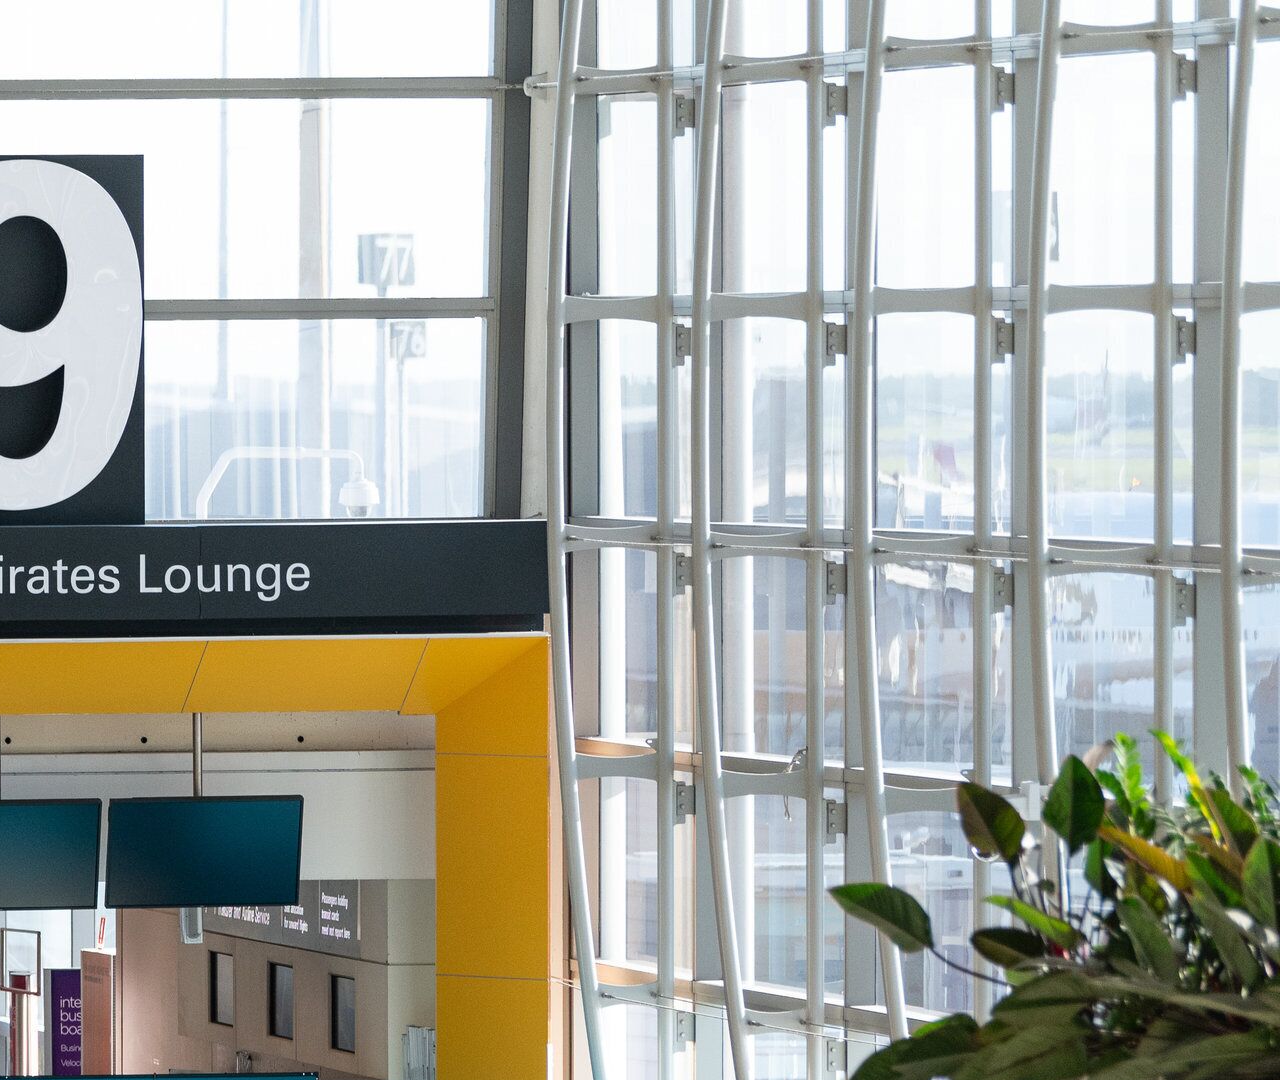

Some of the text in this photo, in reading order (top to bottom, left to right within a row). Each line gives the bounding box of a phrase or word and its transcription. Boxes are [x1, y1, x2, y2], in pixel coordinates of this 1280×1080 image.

[137, 556, 312, 604] Lounge
[60, 996, 82, 1008] inte
[60, 1010, 82, 1022] bus
[60, 1022, 82, 1035] boa
[61, 1044, 81, 1052] Busin
[61, 1059, 81, 1067] Veloc
